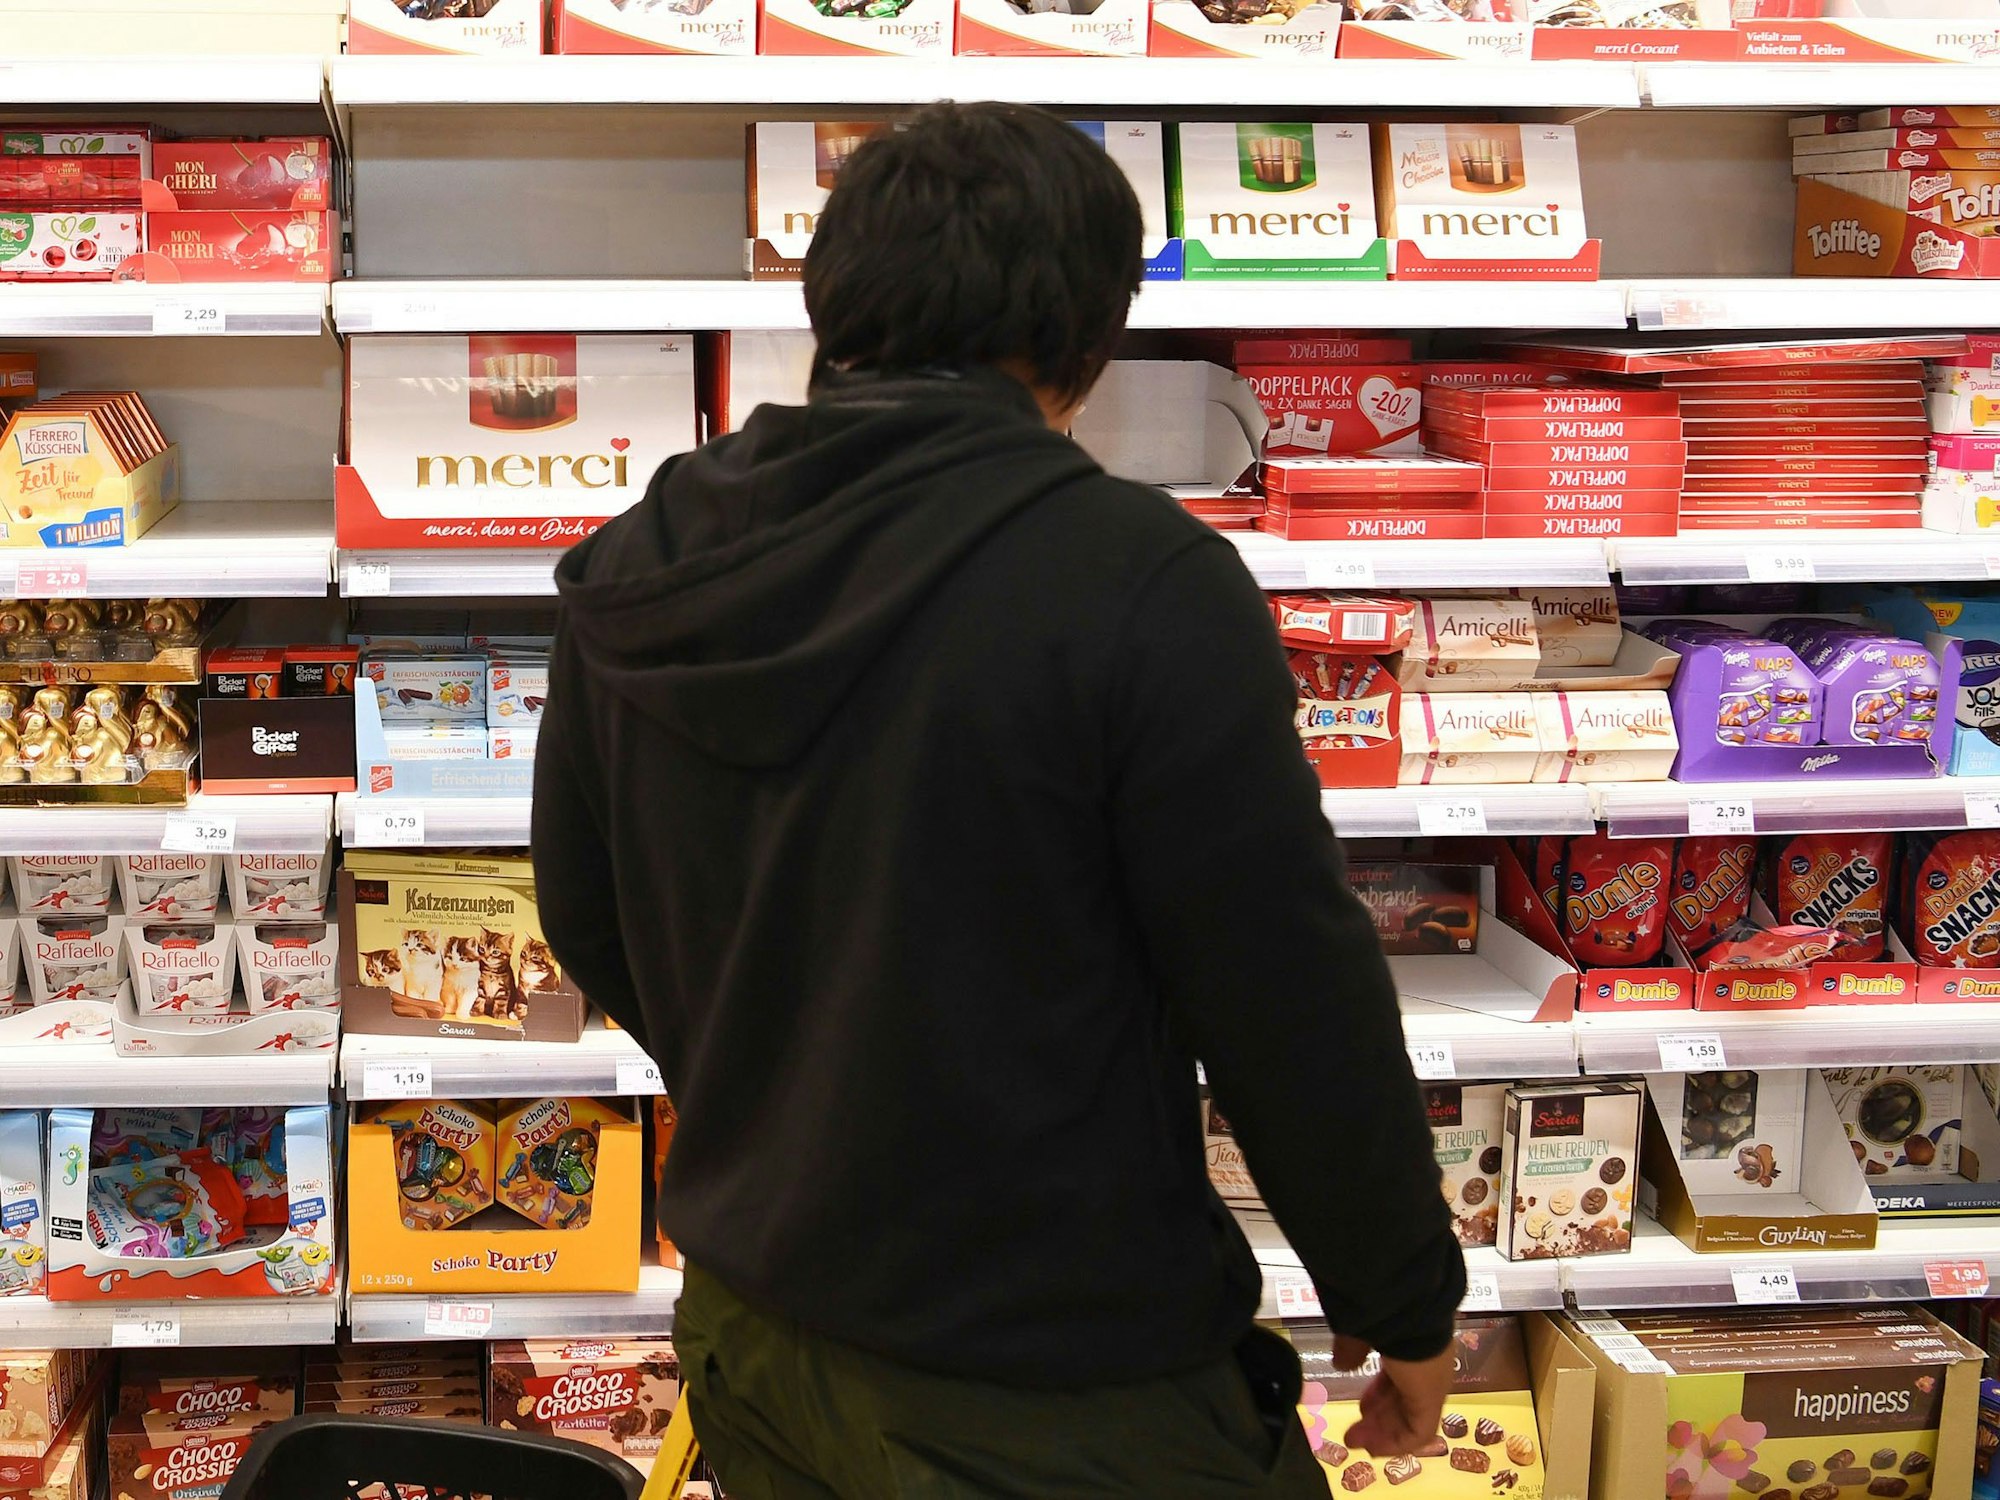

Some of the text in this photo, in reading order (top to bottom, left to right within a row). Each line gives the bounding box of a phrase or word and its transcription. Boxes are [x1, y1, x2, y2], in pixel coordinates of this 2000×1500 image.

[680, 20, 745, 33] merci
[879, 21, 940, 35] merci
[1071, 19, 1133, 33] merci
[1264, 31, 1326, 44] merci
[1746, 32, 1802, 42] Vielfalt zum
[1594, 42, 1680, 54] merci Crocant
[1745, 43, 1845, 55] Anbieten & Teilen
[175, 162, 205, 173] MON
[1401, 151, 1440, 169] Mousse
[163, 174, 217, 189] CHERI
[1402, 166, 1444, 189] Chocolat
[1211, 203, 1350, 236] merci
[1423, 204, 1559, 236] merci
[171, 231, 200, 242] MON
[1808, 220, 1880, 258] Toffifee
[185, 308, 217, 321] 2,29
[1290, 344, 1359, 358] DOPPELPACK
[1785, 348, 1816, 359] merci
[1278, 398, 1352, 410] 2X DANKE SAGEN
[1371, 391, 1413, 416] -20%
[1543, 397, 1621, 413] DOPPELPACK
[29, 429, 78, 441] FERRERO
[1545, 421, 1623, 438] DOPPELPACK
[25, 441, 82, 454] KÜSSCHEN
[1551, 446, 1628, 462] DOPPELPACK
[1782, 443, 1814, 452] merci
[416, 437, 630, 489] merci
[1783, 462, 1815, 470] merci
[16, 463, 81, 493] Zeit für
[1549, 470, 1626, 486] DOPPELPACK
[1778, 480, 1810, 489] merci
[56, 487, 95, 501] Freund
[1544, 494, 1621, 510] DOPPELPACK
[1774, 498, 1806, 507] merci
[1347, 519, 1426, 536] DOPPELPACK
[1543, 518, 1621, 534] DOPPELPACK
[1775, 516, 1808, 525] merci
[56, 529, 64, 544] 1
[66, 518, 121, 543] MILLION
[422, 521, 478, 537] merci,
[480, 519, 516, 537] dass
[519, 524, 536, 537] es
[539, 518, 586, 541] Dich
[360, 565, 386, 575] 5,79
[1775, 558, 1805, 568] 9,99
[46, 572, 81, 586] 2,79
[1531, 596, 1611, 616] Amicelli
[1931, 608, 1954, 618] NEW
[1439, 616, 1528, 637] Amicelli
[1754, 656, 1794, 671] NAPS
[1890, 654, 1927, 669] NAPS
[20, 666, 92, 682] FERRERO
[296, 665, 324, 674] Pocket
[392, 670, 482, 678] ERFRISCHUNGSSTÄBCHEN
[218, 675, 246, 685] Pocket
[296, 673, 322, 682] Coffee
[1511, 680, 1560, 689] Amicelli
[218, 684, 245, 693] Coffee
[1577, 707, 1663, 729] Amicelli
[1974, 706, 1995, 717] fills
[1438, 709, 1526, 730] Amicelli
[252, 727, 299, 742] Pocket
[252, 741, 297, 755] Coffee
[1801, 753, 1841, 772] Milka
[432, 774, 499, 786] Erfrischend
[1446, 807, 1476, 818] 2,79
[1716, 806, 1745, 818] 2,79
[384, 817, 416, 829] 0,79
[195, 827, 226, 839] 3,29
[128, 854, 207, 870] Raffaello
[239, 854, 318, 870] Raffaello
[455, 861, 500, 874] Katzenzungen
[1790, 852, 1842, 904] Dumle
[1670, 844, 1754, 930] Dumle
[1791, 856, 1880, 928] SNACKS
[1924, 865, 1979, 918] Dumle
[405, 888, 515, 917] Katzenzungen
[1565, 862, 1661, 934] Dumle
[1625, 895, 1658, 920] original
[1846, 911, 1880, 919] original
[412, 911, 484, 922] Vollmilch-Schokolade
[37, 942, 114, 959] Raffaello
[142, 951, 220, 969] Raffaello
[253, 950, 332, 967] Raffaello
[1614, 978, 1681, 1002] Dumle
[1731, 977, 1797, 1001] Dumle
[1838, 973, 1906, 996] Dumle
[438, 1023, 477, 1037] Sarotti
[124, 1042, 157, 1052] Raffaello
[1688, 1045, 1717, 1057] 1,59
[1416, 1051, 1444, 1063] 1,19
[394, 1072, 425, 1085] 1,19
[435, 1104, 475, 1129] Schoko
[518, 1099, 556, 1131] Schoko
[1534, 1112, 1581, 1128] Sarotti
[126, 1117, 157, 1129] mini
[418, 1108, 481, 1150] Party
[513, 1100, 572, 1150] Party
[1445, 1128, 1488, 1150] FREUDEN
[1528, 1139, 1610, 1160] KLEINE FREUDEN
[432, 1249, 558, 1275] Schoko Party
[361, 1274, 413, 1288] 12 x 250 g
[1760, 1275, 1788, 1287] 4,49
[1951, 1269, 1982, 1281] 1,99
[454, 1308, 485, 1321] 1,99
[141, 1321, 173, 1333] 1,79
[1896, 1337, 1946, 1348] happiness
[1914, 1349, 1966, 1360] happiness
[553, 1372, 623, 1398] CHOCO
[176, 1387, 243, 1414] CHOCO
[536, 1388, 634, 1419] CROSSIES
[1794, 1386, 1911, 1422] happiness
[168, 1441, 237, 1469] CHOCO
[175, 1485, 225, 1500] Original
